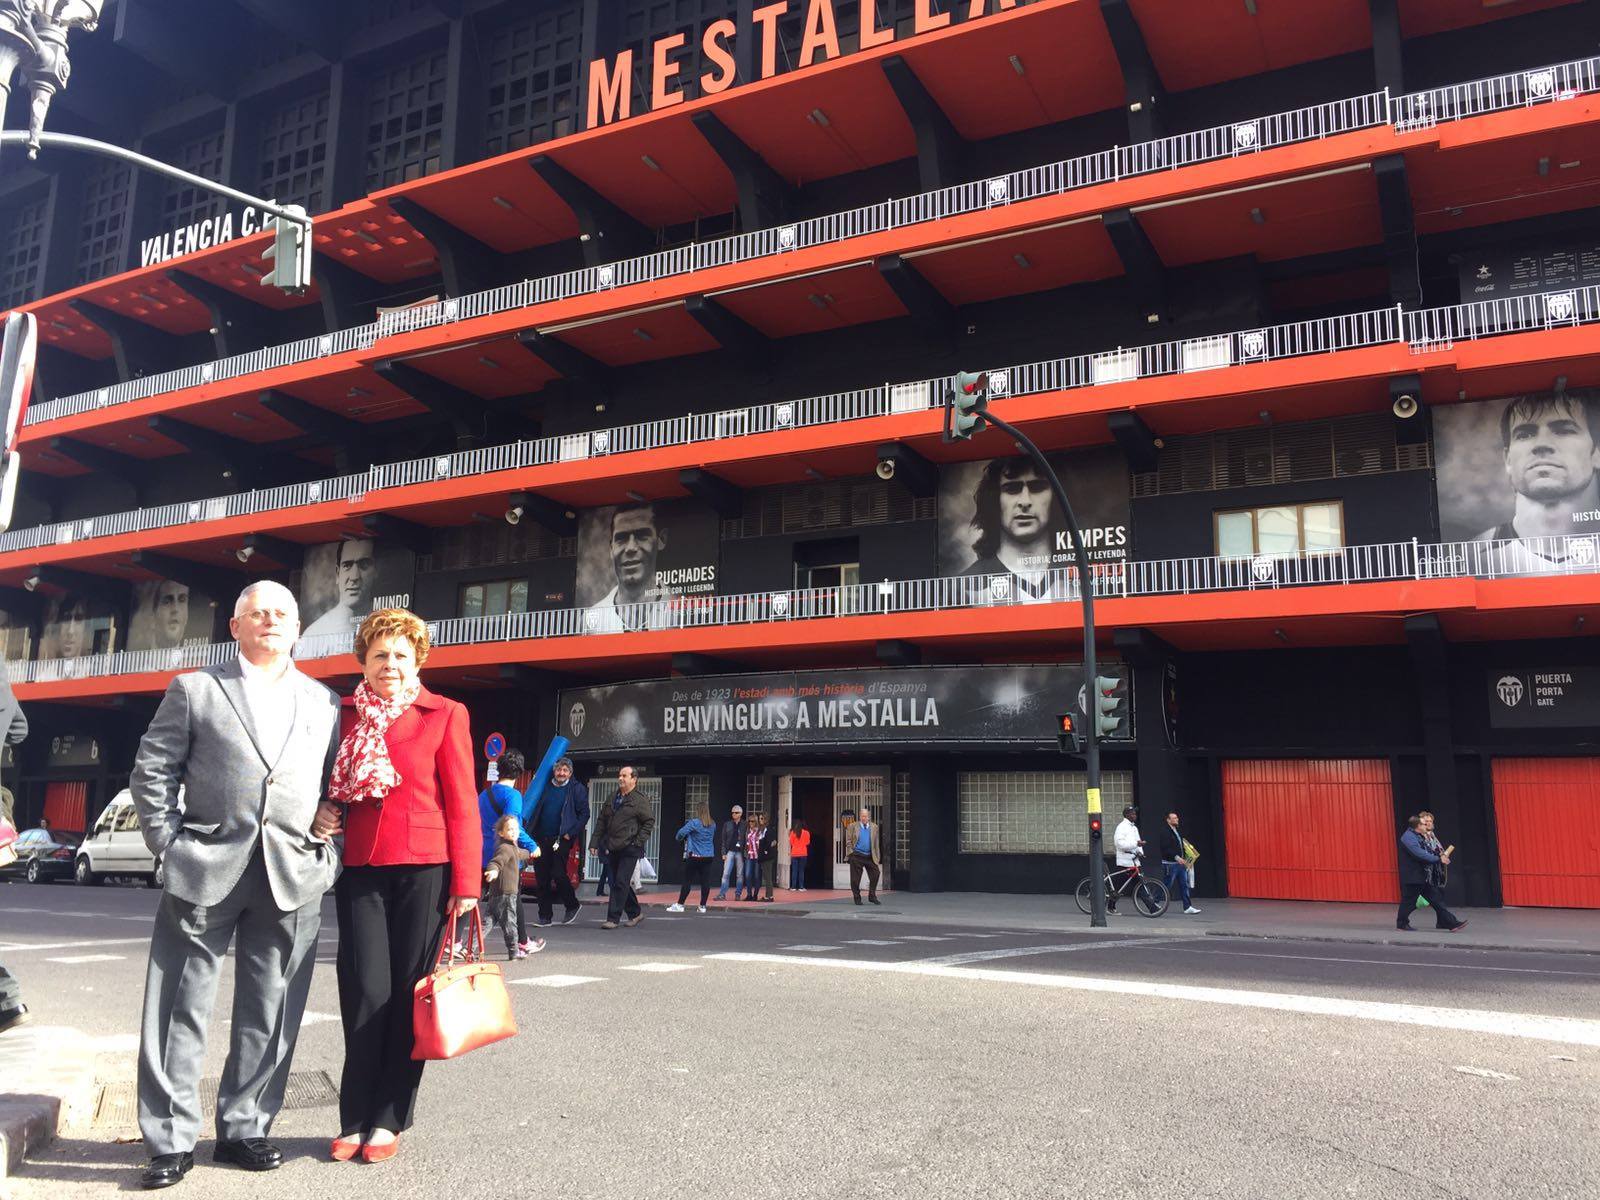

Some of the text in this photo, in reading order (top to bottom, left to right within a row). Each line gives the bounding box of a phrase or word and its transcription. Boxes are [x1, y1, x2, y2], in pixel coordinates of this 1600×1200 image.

[141, 212, 233, 268] VALENCIA
[1056, 526, 1126, 550] KEMPES
[1052, 553, 1076, 563] CORAZ
[1087, 551, 1093, 560] Y
[1093, 548, 1127, 559] LEYENDA
[656, 565, 715, 585] PUCHADES
[687, 583, 715, 593] LLEGENDA
[373, 593, 410, 611] MUNDO
[1535, 673, 1573, 684] PUERTA
[672, 690, 688, 702] Des
[690, 690, 702, 701] de
[705, 688, 731, 700] 1923
[868, 682, 927, 697] d'Espanya
[1536, 687, 1564, 696] PORTA
[1537, 698, 1555, 706] GATE
[664, 697, 939, 733] BENVINGUTS A MESTALLA
